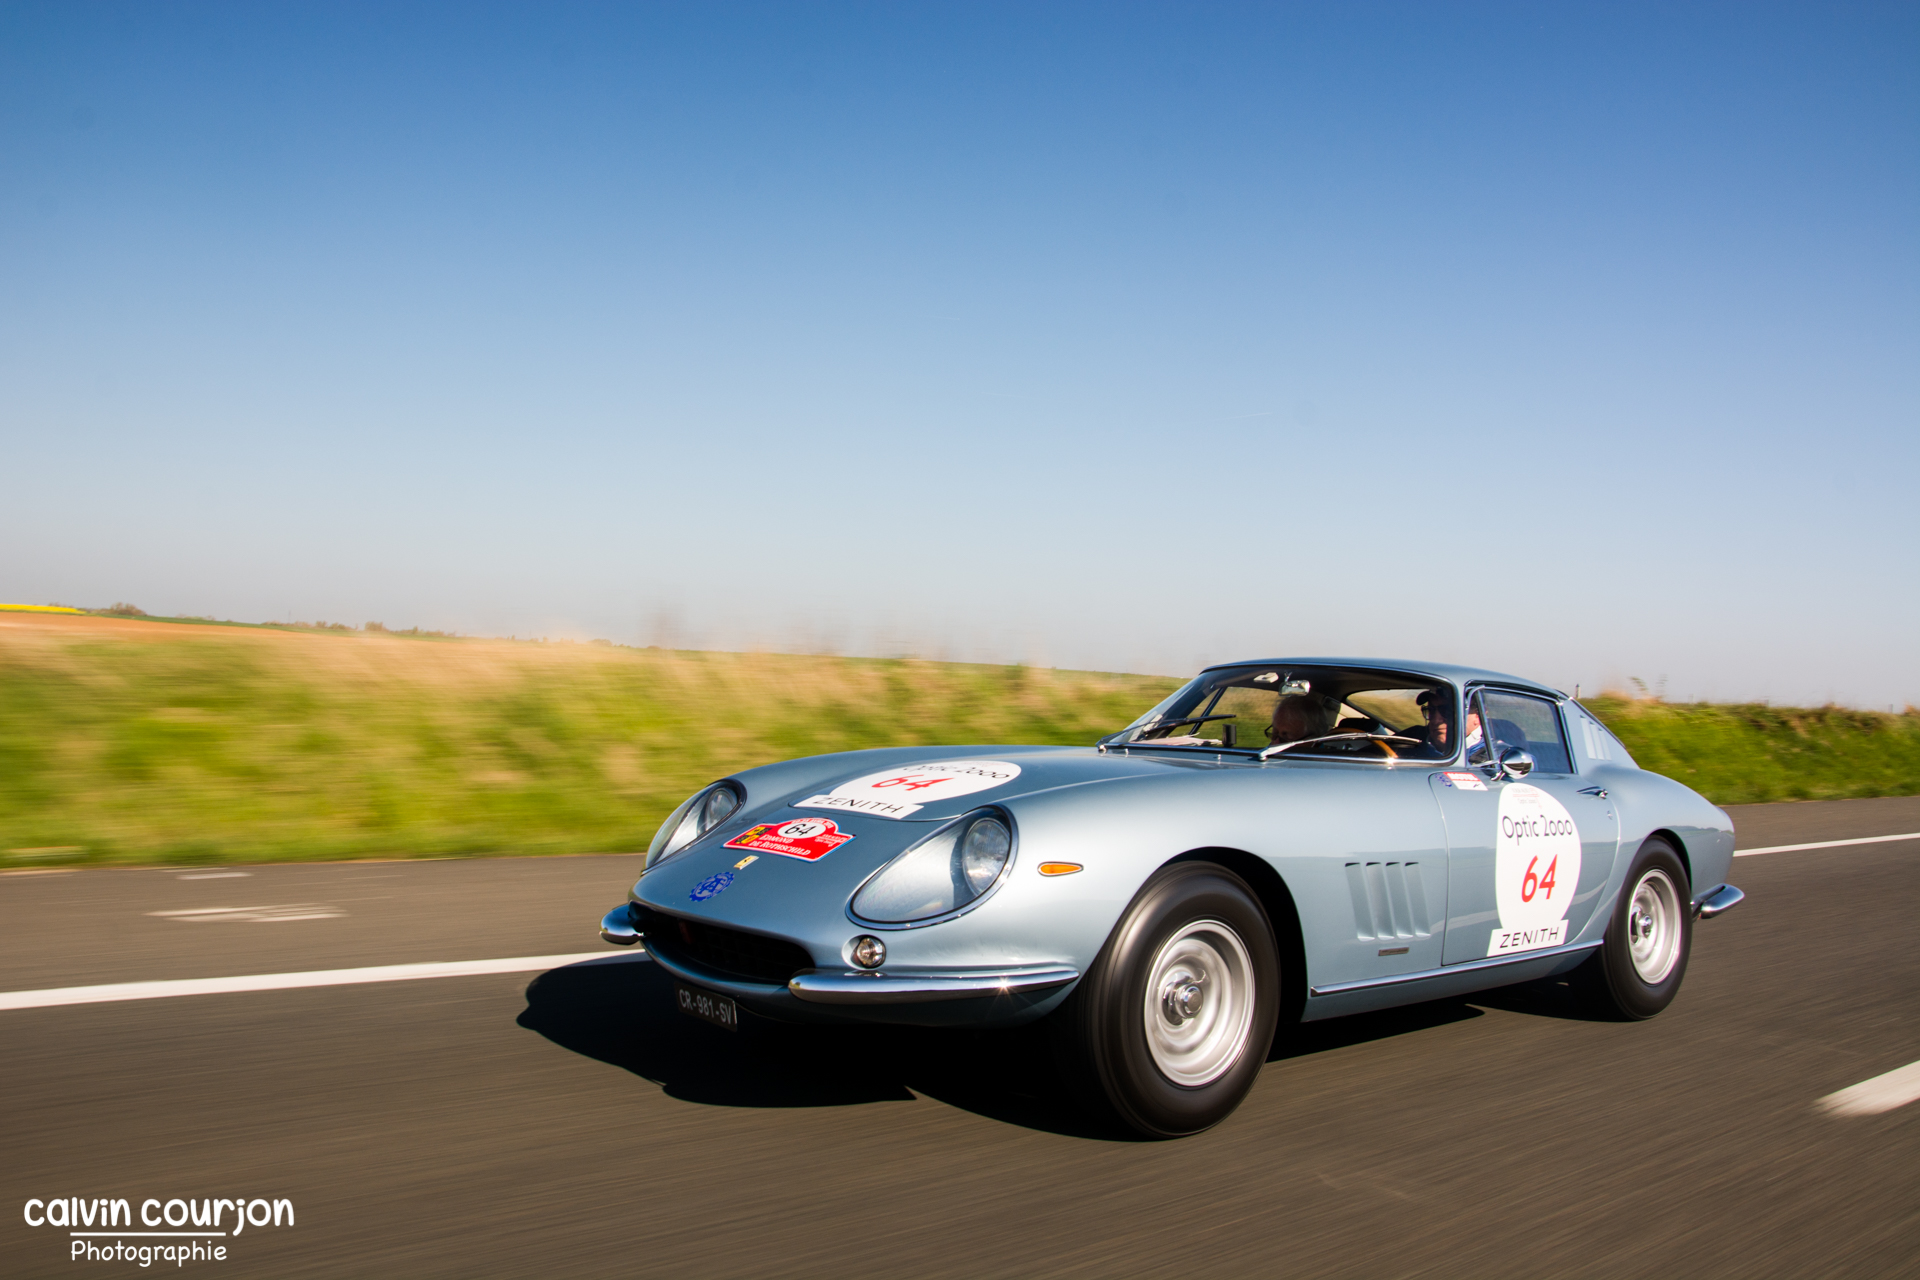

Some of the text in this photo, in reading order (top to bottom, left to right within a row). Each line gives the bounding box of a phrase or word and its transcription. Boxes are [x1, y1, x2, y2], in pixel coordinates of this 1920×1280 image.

[871, 774, 954, 792] 64
[813, 796, 905, 814] ZENITH
[784, 823, 817, 837] 64
[1502, 814, 1573, 846] Optic 2000
[1521, 854, 1558, 903] 64
[1500, 926, 1560, 949] ZENITH
[679, 989, 732, 1025] CR-981-SV
